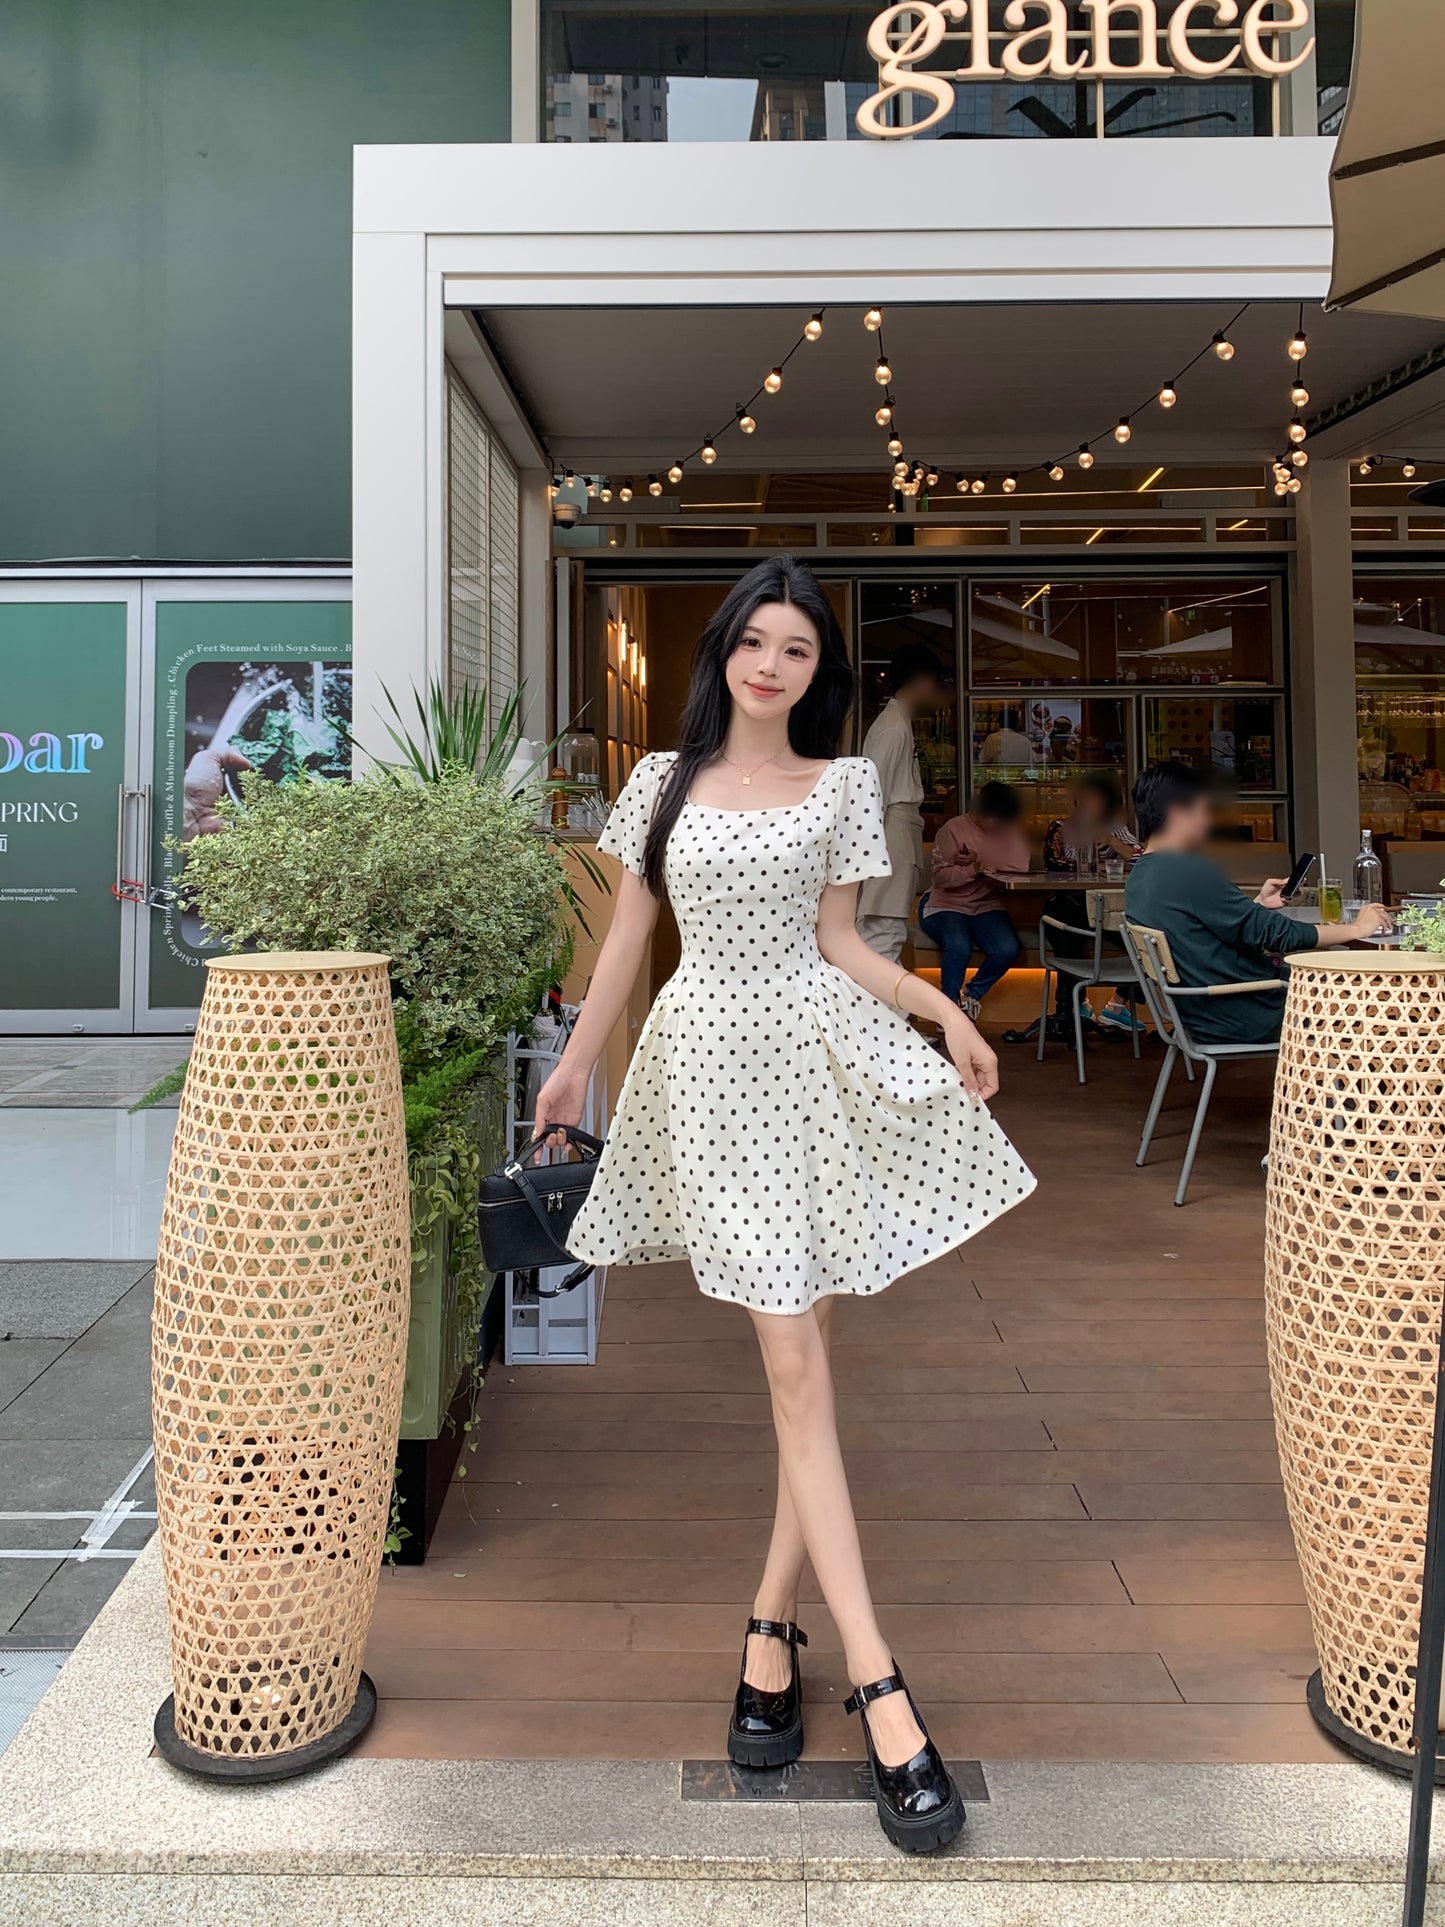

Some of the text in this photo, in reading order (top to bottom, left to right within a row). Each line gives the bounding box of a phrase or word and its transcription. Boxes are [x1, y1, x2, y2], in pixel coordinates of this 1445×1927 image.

[855, 0, 1316, 138] glance
[196, 643, 218, 653] Feet
[220, 643, 260, 653] Steamed
[262, 643, 284, 653] with
[286, 644, 309, 655] Soya
[310, 644, 338, 653] Sauce
[167, 647, 195, 683] Chicken
[166, 688, 178, 738] Dumpling
[165, 739, 175, 792] Mushroom
[165, 793, 174, 802] &
[1, 801, 79, 823] PRING
[0, 887, 43, 895] contemporary
[162, 902, 174, 936] Spring
[166, 937, 199, 967] Chicken
